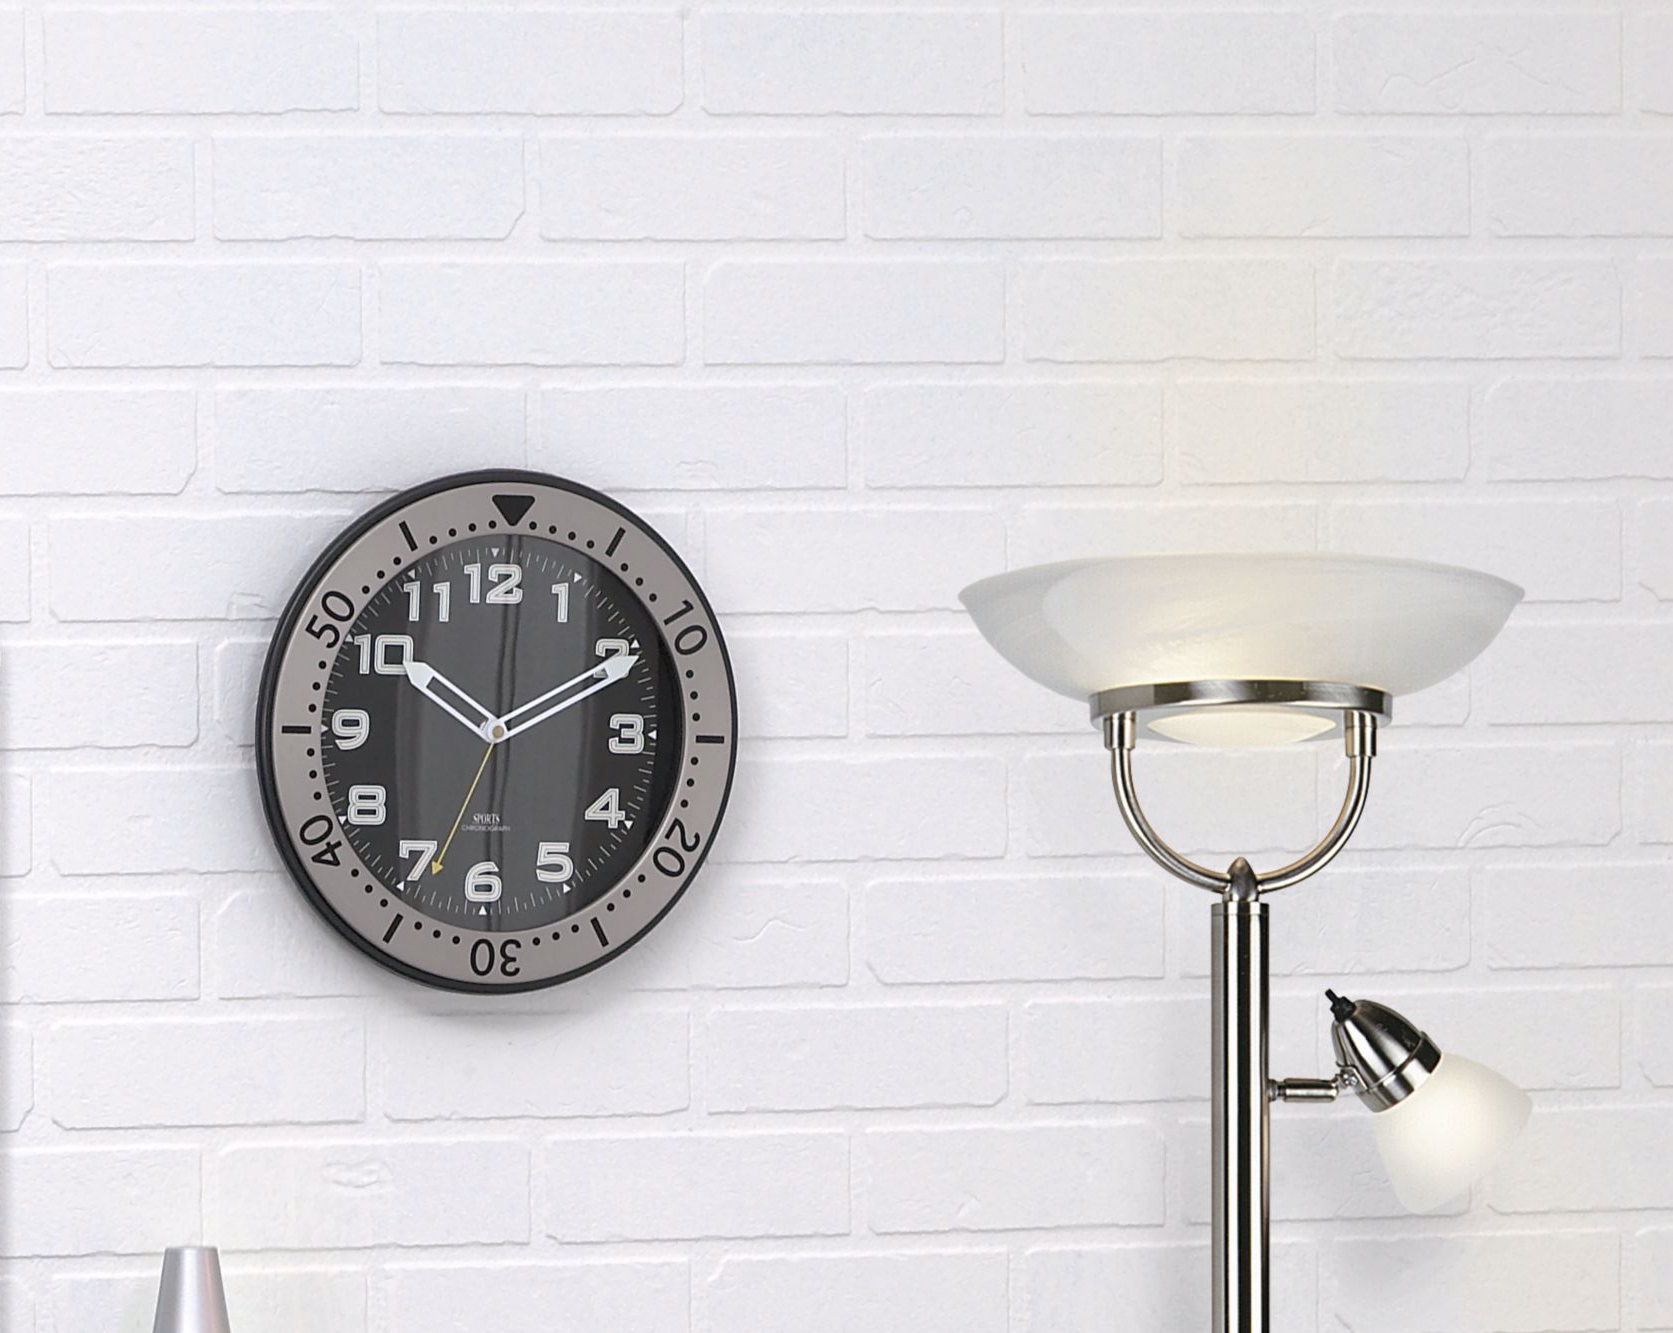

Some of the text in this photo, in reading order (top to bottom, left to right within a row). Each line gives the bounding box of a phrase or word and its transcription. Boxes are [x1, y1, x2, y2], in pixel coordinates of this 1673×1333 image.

[404, 582, 451, 622] 11
[464, 563, 523, 604] 12
[551, 583, 569, 623] 1
[354, 634, 414, 675] 10
[332, 709, 370, 750] 9
[609, 713, 644, 754] 3
[347, 785, 386, 825] 8
[585, 788, 625, 828] 4
[399, 840, 438, 880] 7
[536, 841, 573, 883] 5
[464, 861, 501, 902] 6
